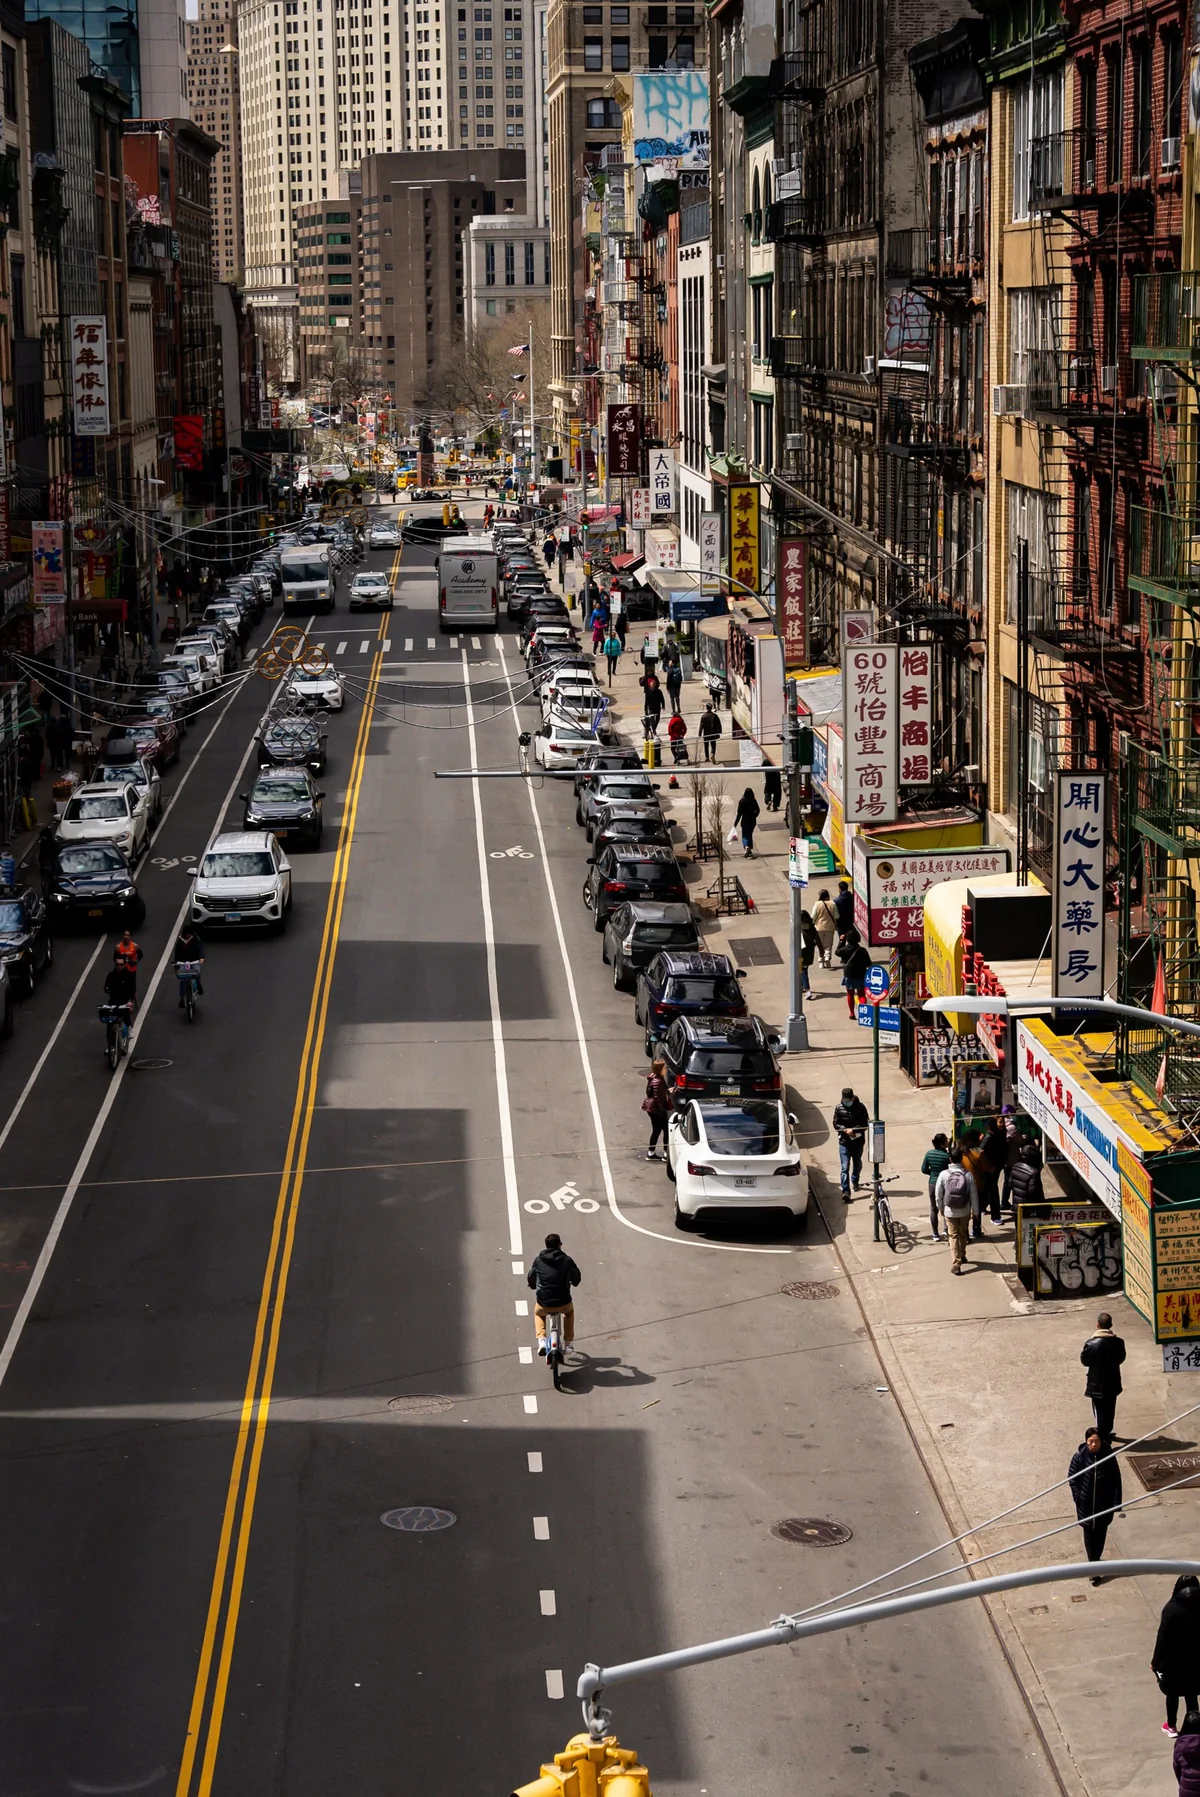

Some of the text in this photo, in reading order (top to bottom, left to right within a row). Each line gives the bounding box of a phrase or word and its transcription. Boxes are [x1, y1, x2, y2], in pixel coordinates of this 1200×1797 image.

[654, 453, 671, 510] 大帝國
[734, 491, 756, 590] 華美商場
[450, 575, 487, 586] Academy
[784, 548, 803, 641] 農家飯莊
[78, 613, 98, 621] Bank
[1060, 783, 1100, 983] 開心大藥房
[908, 929, 922, 937] TEL
[859, 1016, 872, 1026] M22
